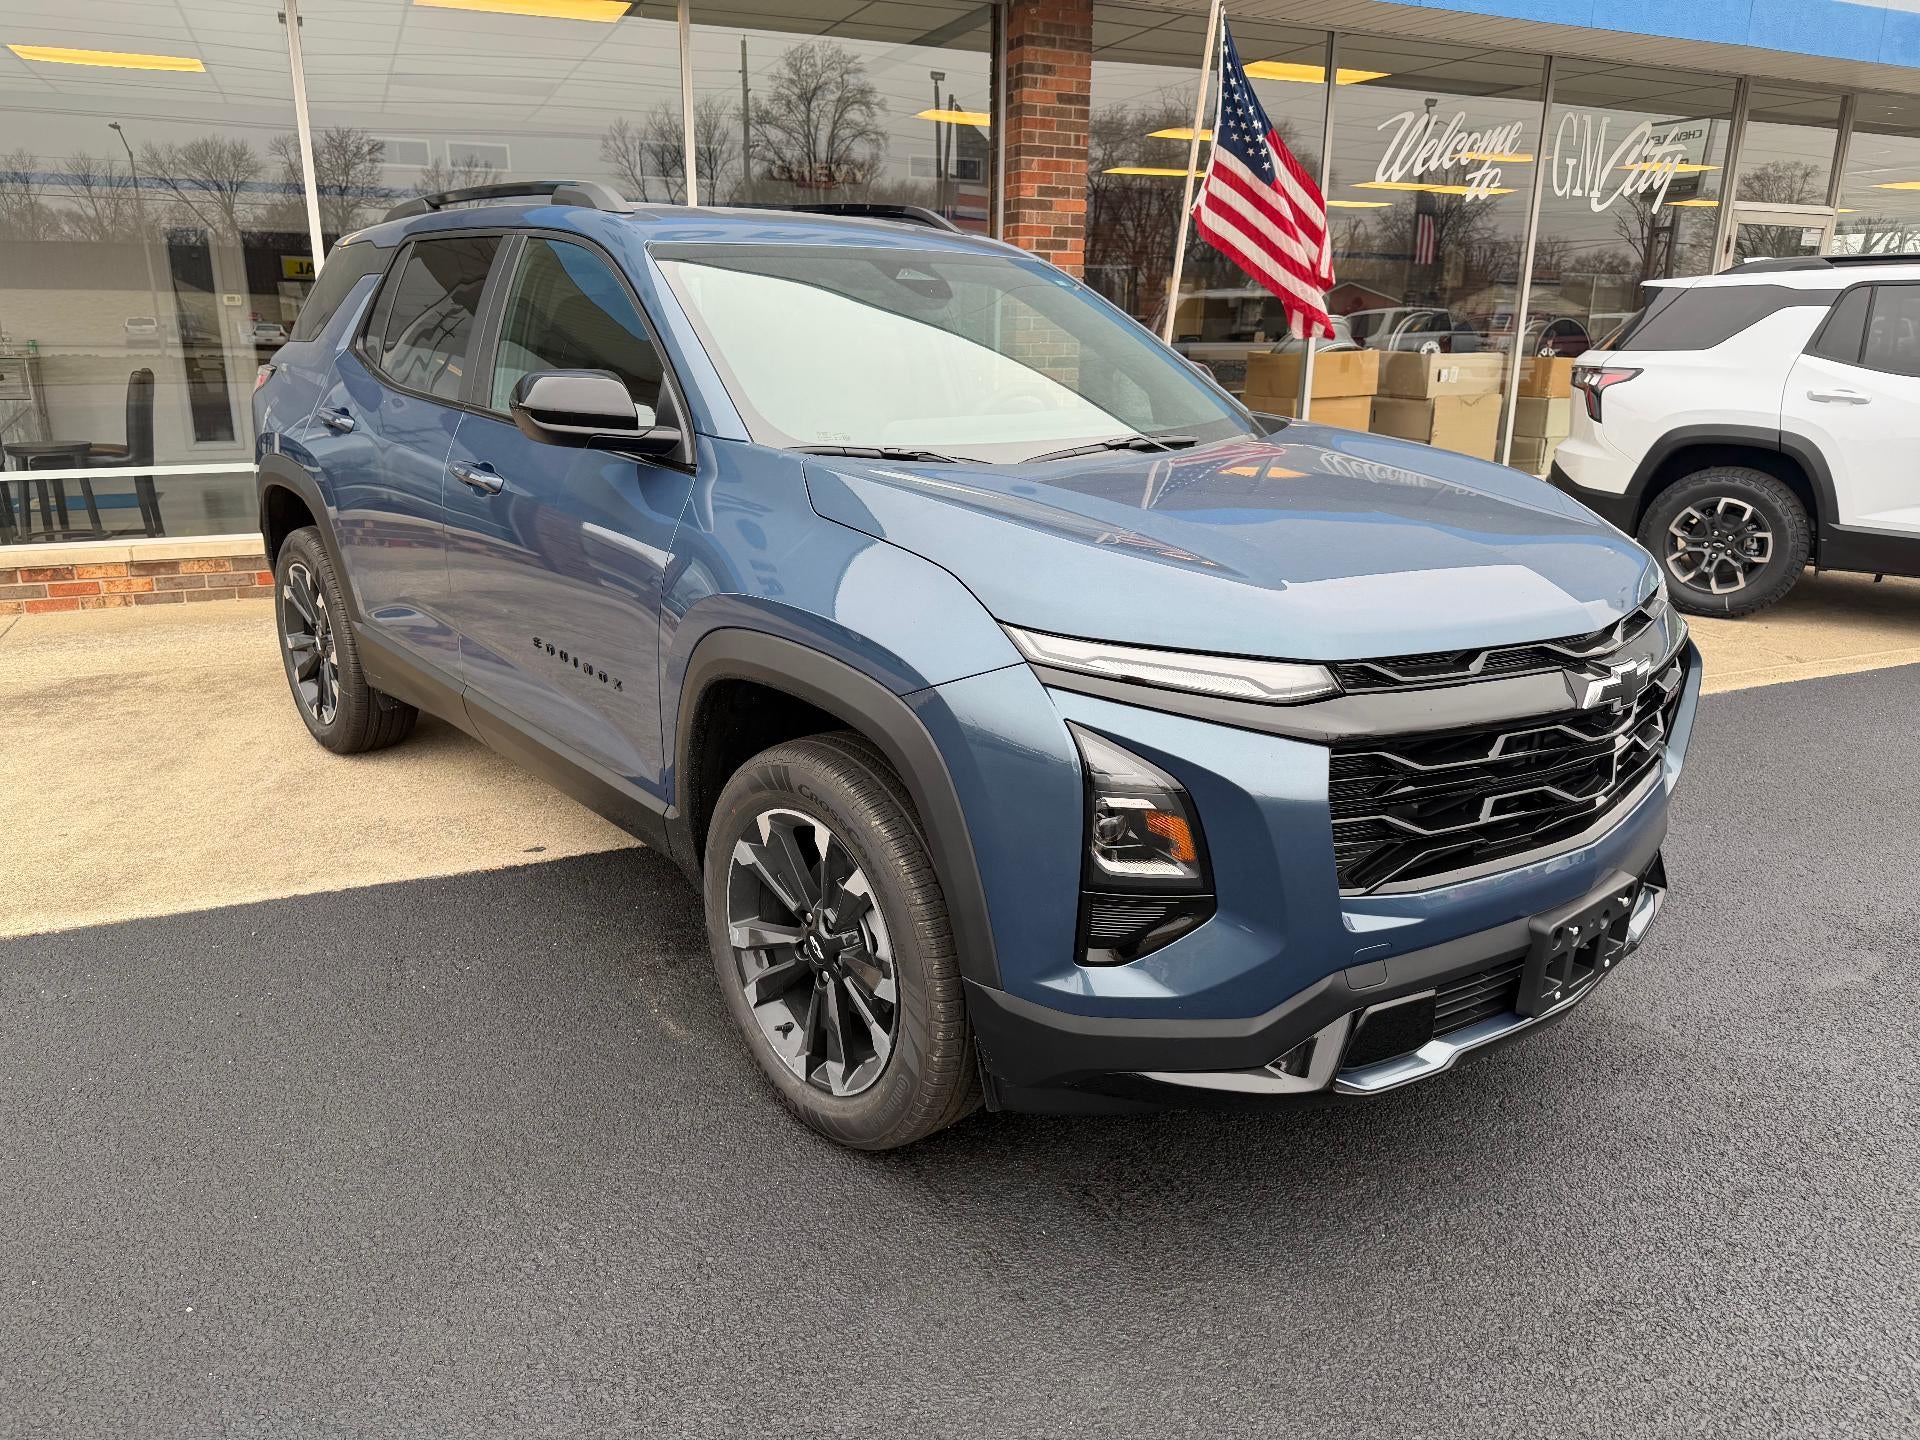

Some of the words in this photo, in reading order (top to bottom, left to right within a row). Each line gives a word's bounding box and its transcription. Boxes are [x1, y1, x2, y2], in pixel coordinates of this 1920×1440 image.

[1375, 111, 1523, 184] Welcome
[1552, 112, 1611, 199] GM
[1590, 120, 1687, 214] City
[1462, 160, 1502, 203] to
[532, 637, 623, 692] EQUINOX
